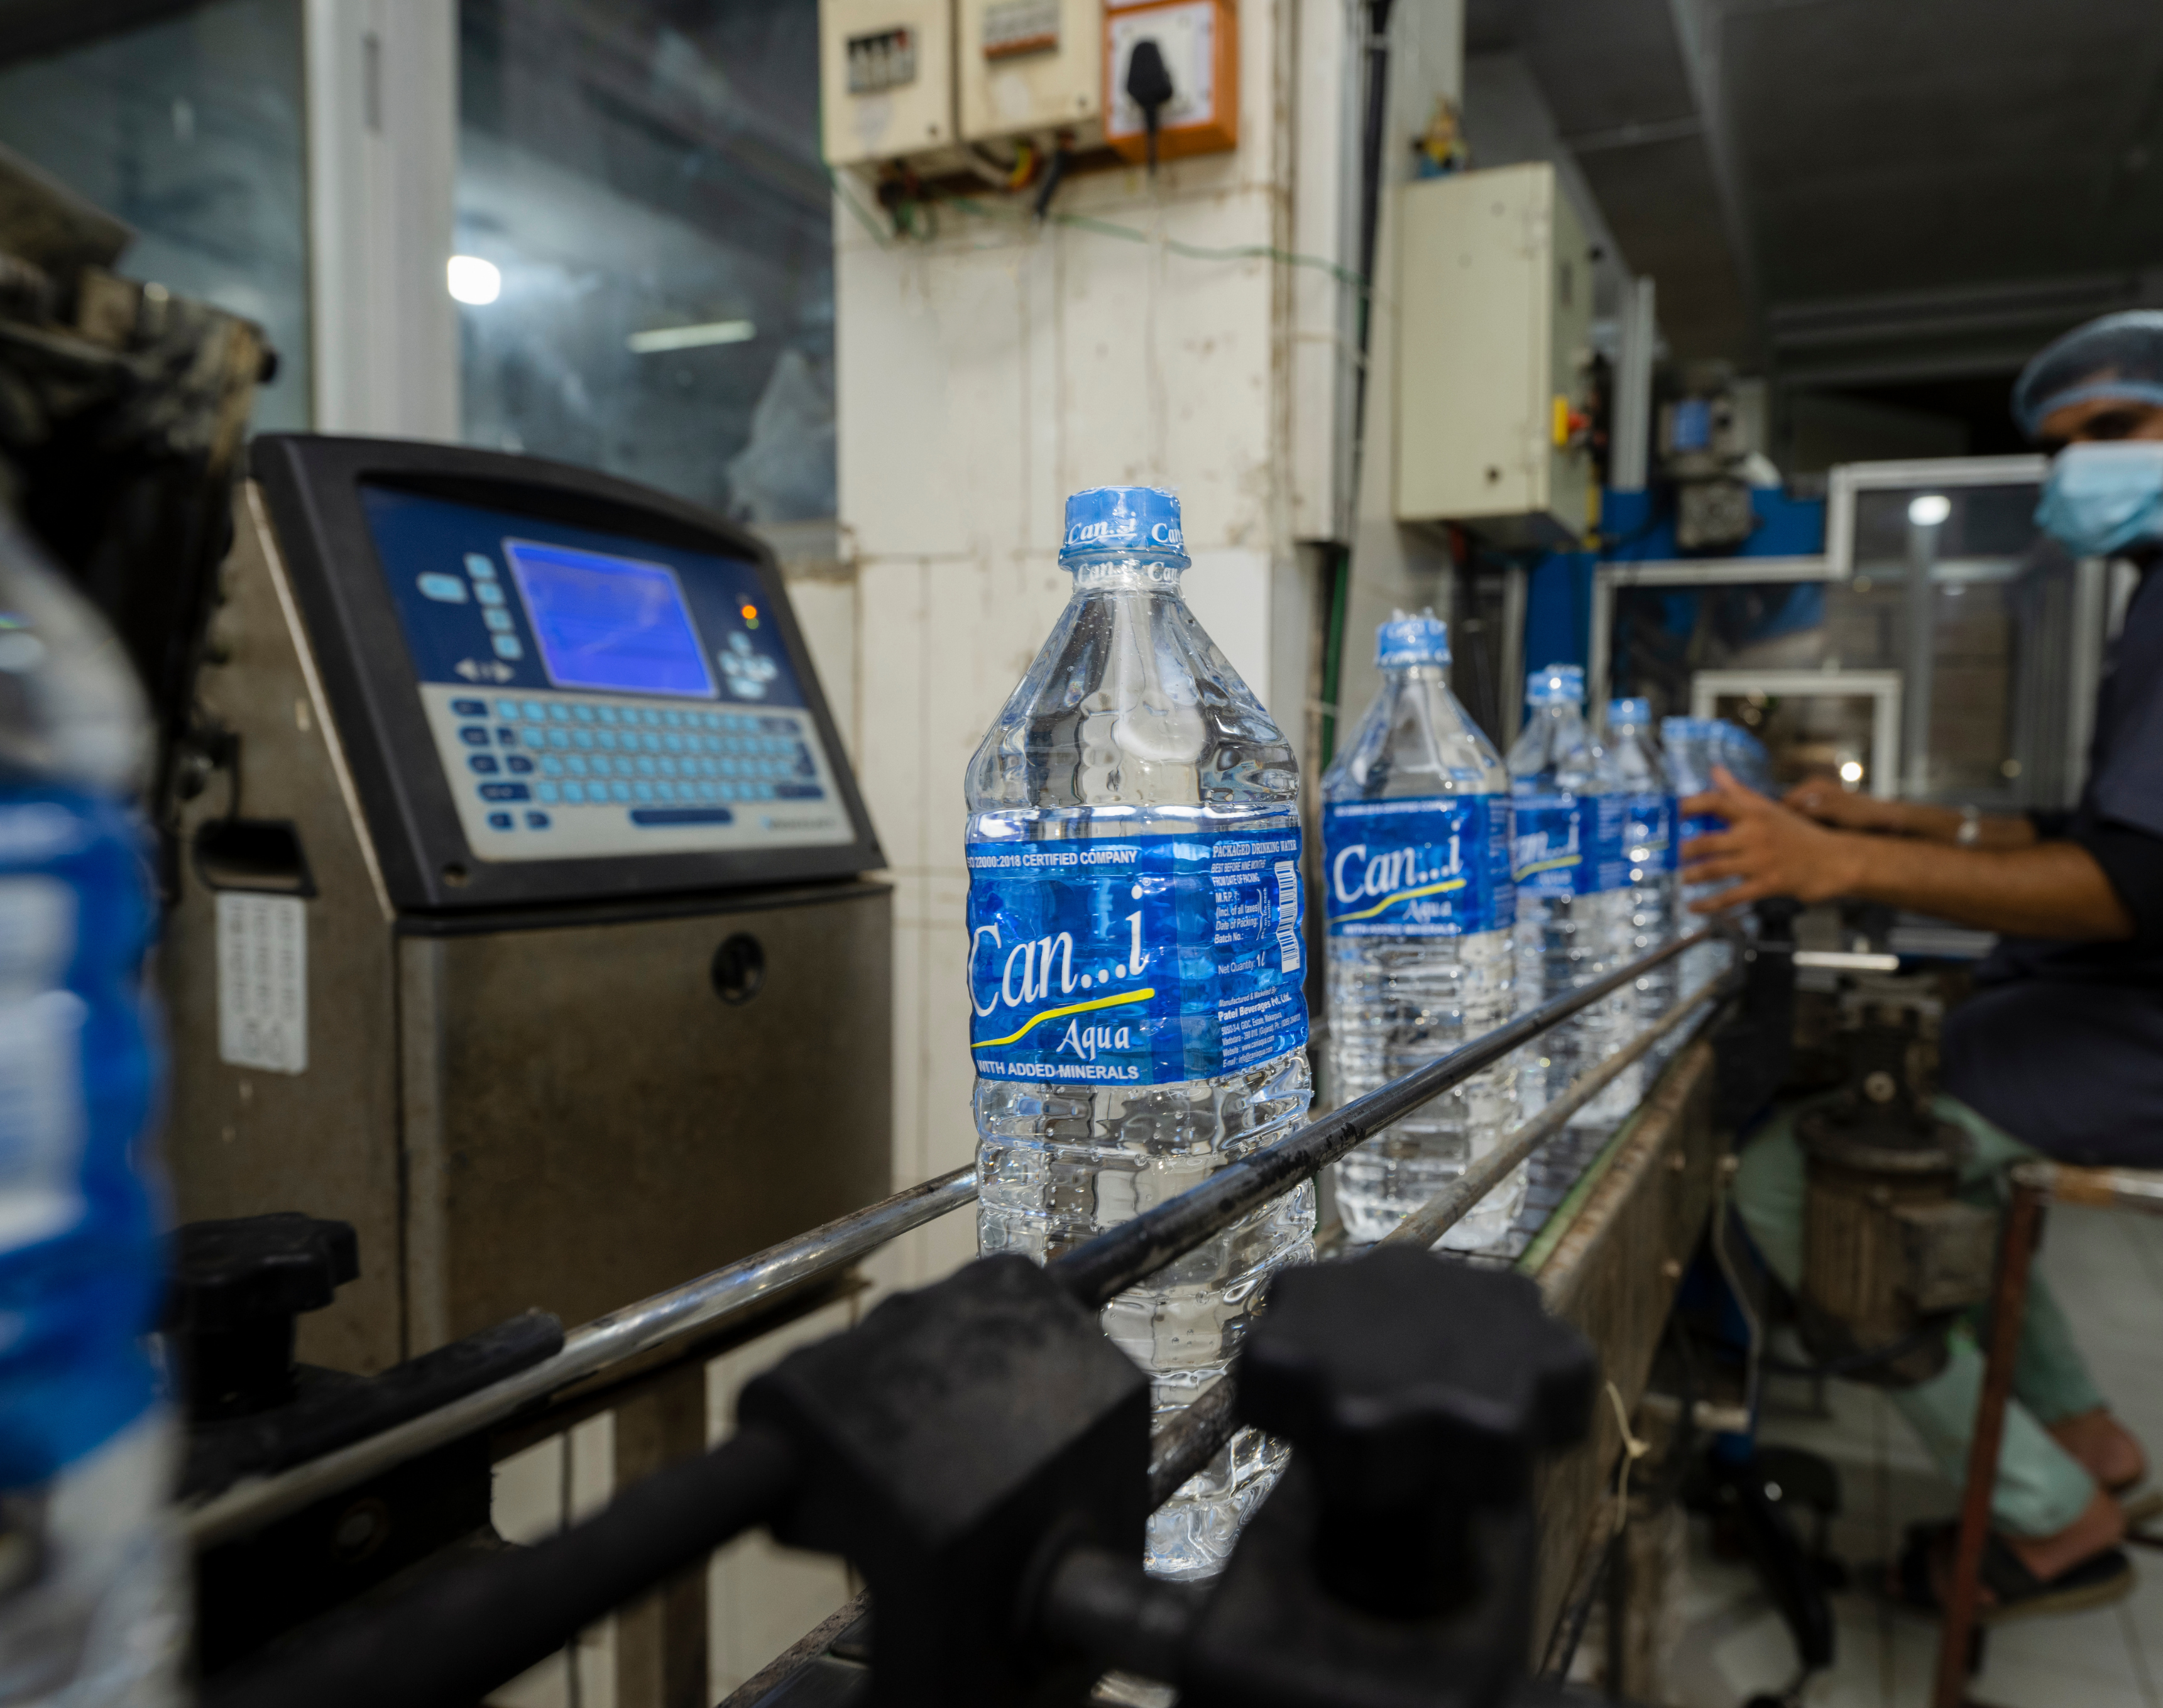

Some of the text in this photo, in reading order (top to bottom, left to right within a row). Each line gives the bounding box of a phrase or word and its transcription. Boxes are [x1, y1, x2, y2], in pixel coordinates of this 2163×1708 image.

[1212, 840, 1297, 858] PACKAGED DRINKING WATER
[975, 855, 1021, 868] 22000:2018
[1022, 853, 1078, 866] CERTIFIED
[1080, 850, 1138, 865] COMPANY
[1211, 859, 1266, 873] BEST BEFORE NINE MONTHS
[1212, 872, 1261, 886] FROM DATE OF PACKING
[1215, 892, 1233, 902] M.R.P.
[1216, 906, 1230, 920] (Incl.
[1231, 905, 1237, 916] of
[1245, 901, 1259, 914] taxes)
[1215, 921, 1229, 931] Date
[1230, 919, 1236, 929] of
[1214, 933, 1232, 944] Batch
[968, 885, 1149, 1017] Can...i
[1218, 964, 1230, 975] Net
[1230, 960, 1256, 972] Quantity:
[1218, 994, 1249, 1007] Manufactured
[1254, 988, 1270, 999] Marketed
[1218, 992, 1292, 1022] Patel Beverages Pvt. Ltd.
[1252, 1017, 1264, 1027] Estate,
[1056, 1019, 1131, 1063] Aqua
[1222, 1046, 1239, 1057] Website
[1223, 1056, 1235, 1068] E-mail
[977, 1060, 1139, 1080] WITH ADDED MINERALS
